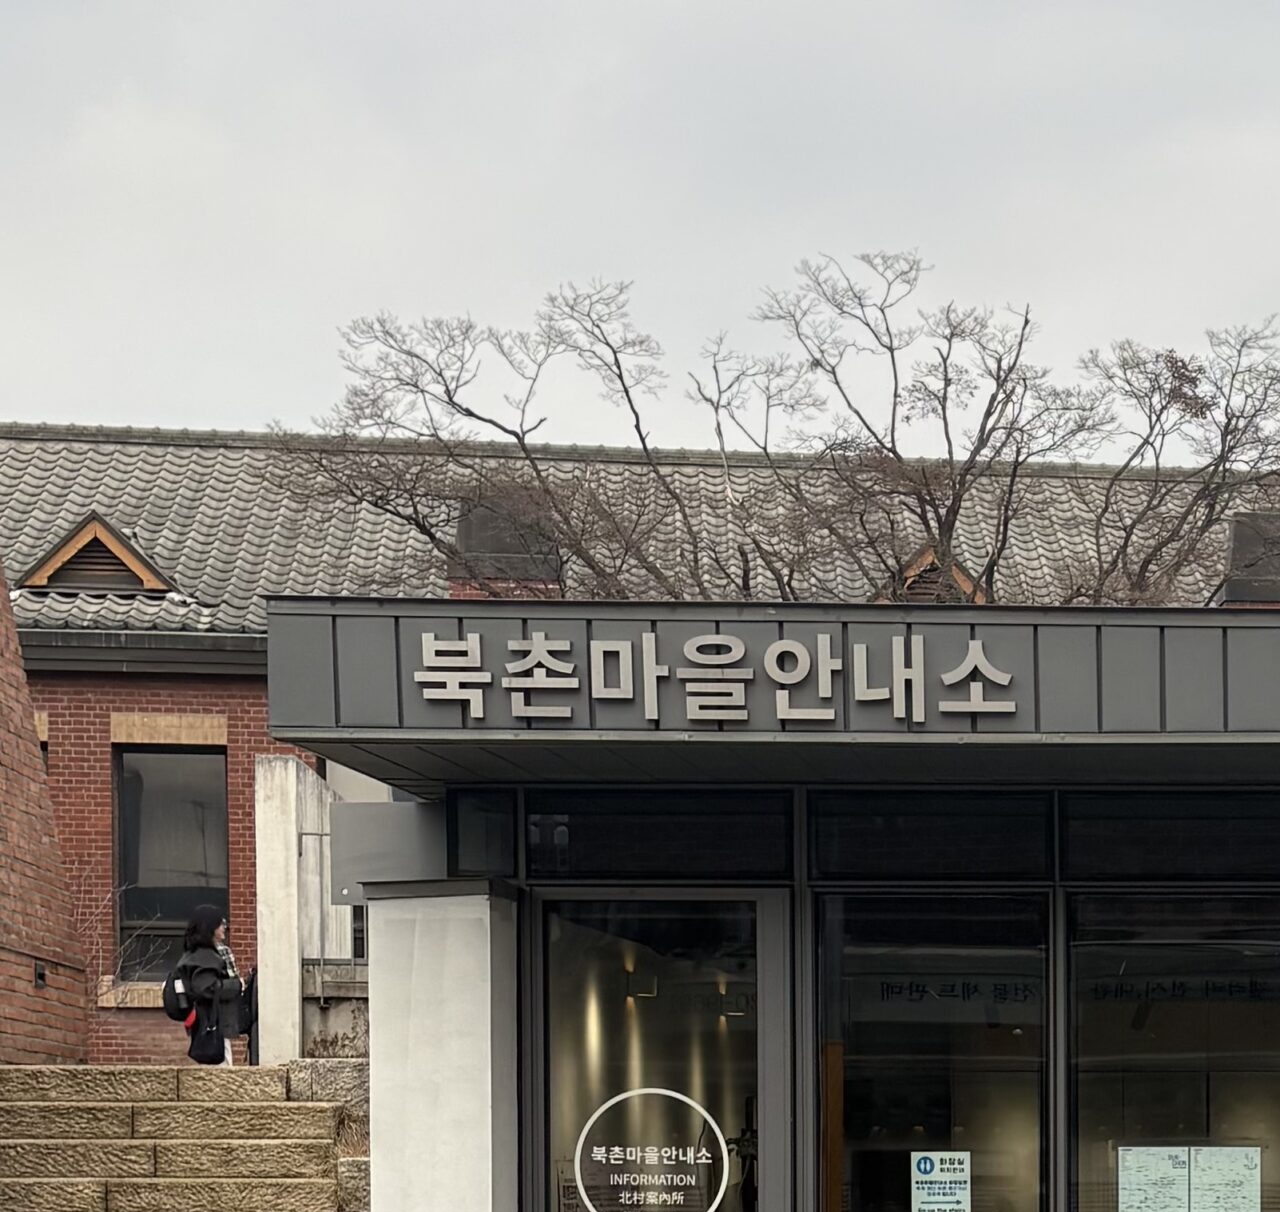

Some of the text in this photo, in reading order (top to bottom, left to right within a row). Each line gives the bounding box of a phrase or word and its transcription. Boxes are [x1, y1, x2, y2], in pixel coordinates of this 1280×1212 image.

[414, 630, 1017, 723] 북촌마을안내소
[591, 1145, 713, 1165] 북촌마을안내소
[609, 1173, 696, 1187] INFORMATION
